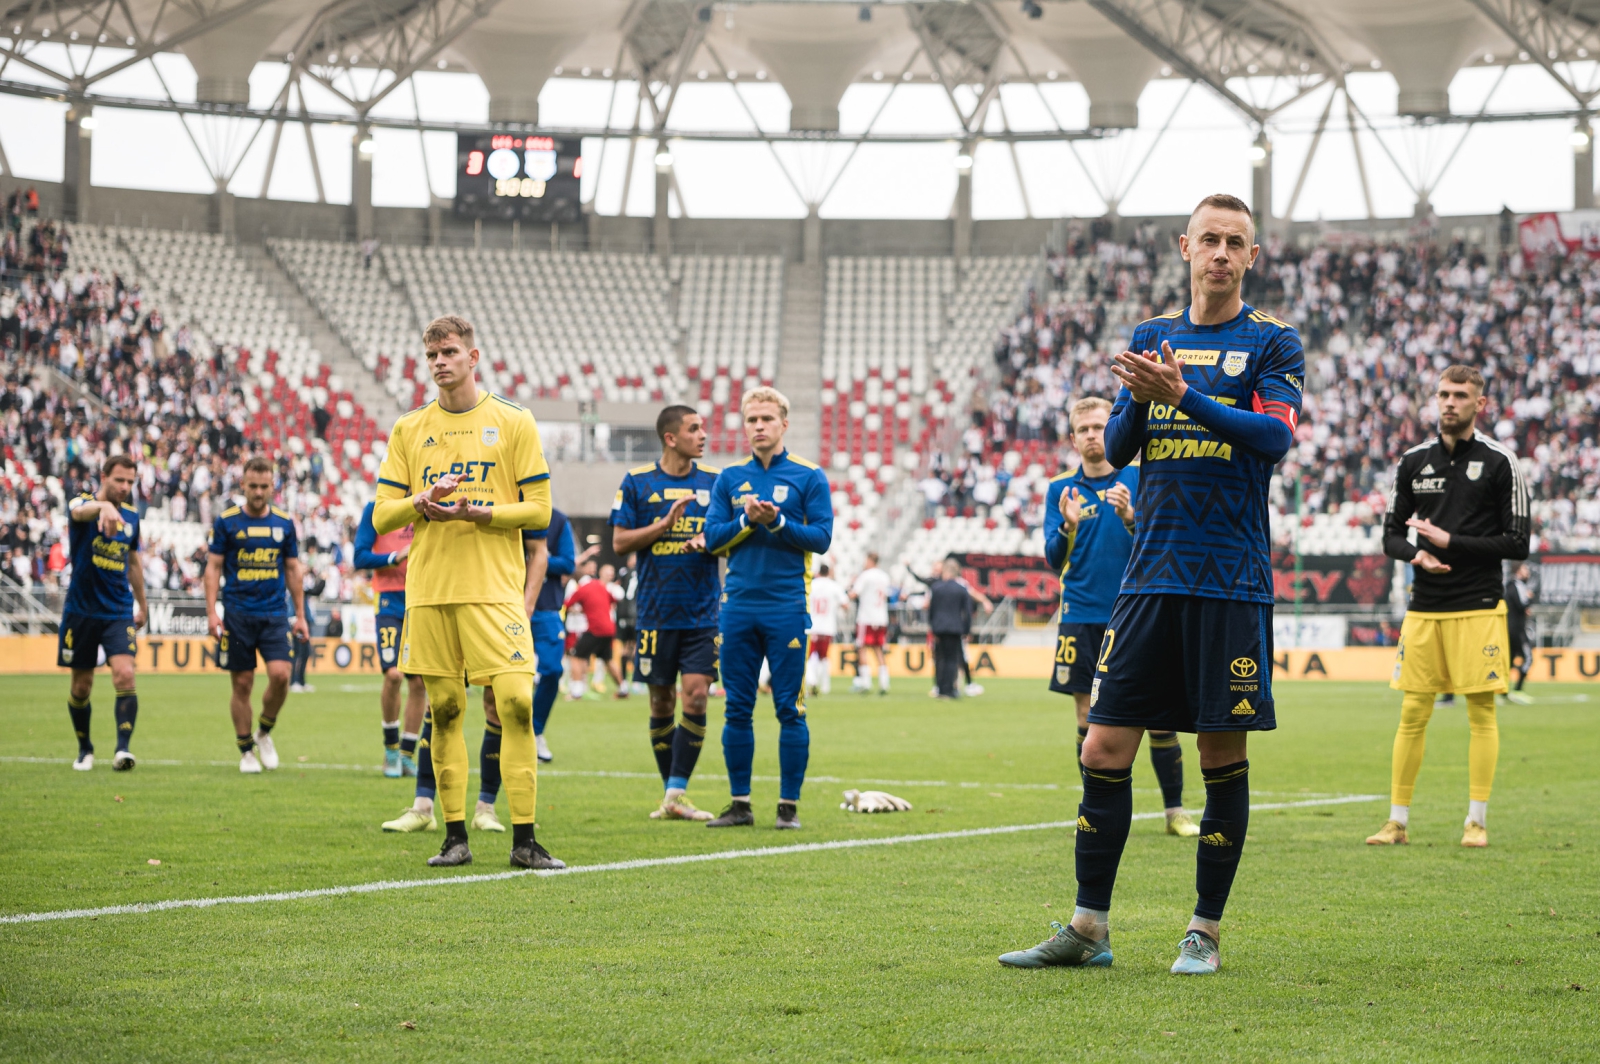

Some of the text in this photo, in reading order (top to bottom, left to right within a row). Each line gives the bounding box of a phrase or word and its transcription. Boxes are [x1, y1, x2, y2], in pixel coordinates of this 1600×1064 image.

[1146, 438, 1232, 461] GDYNIA
[379, 626, 397, 648] 37
[638, 629, 658, 655] 31
[1055, 635, 1077, 664] 26
[1229, 684, 1258, 692] WALDER
